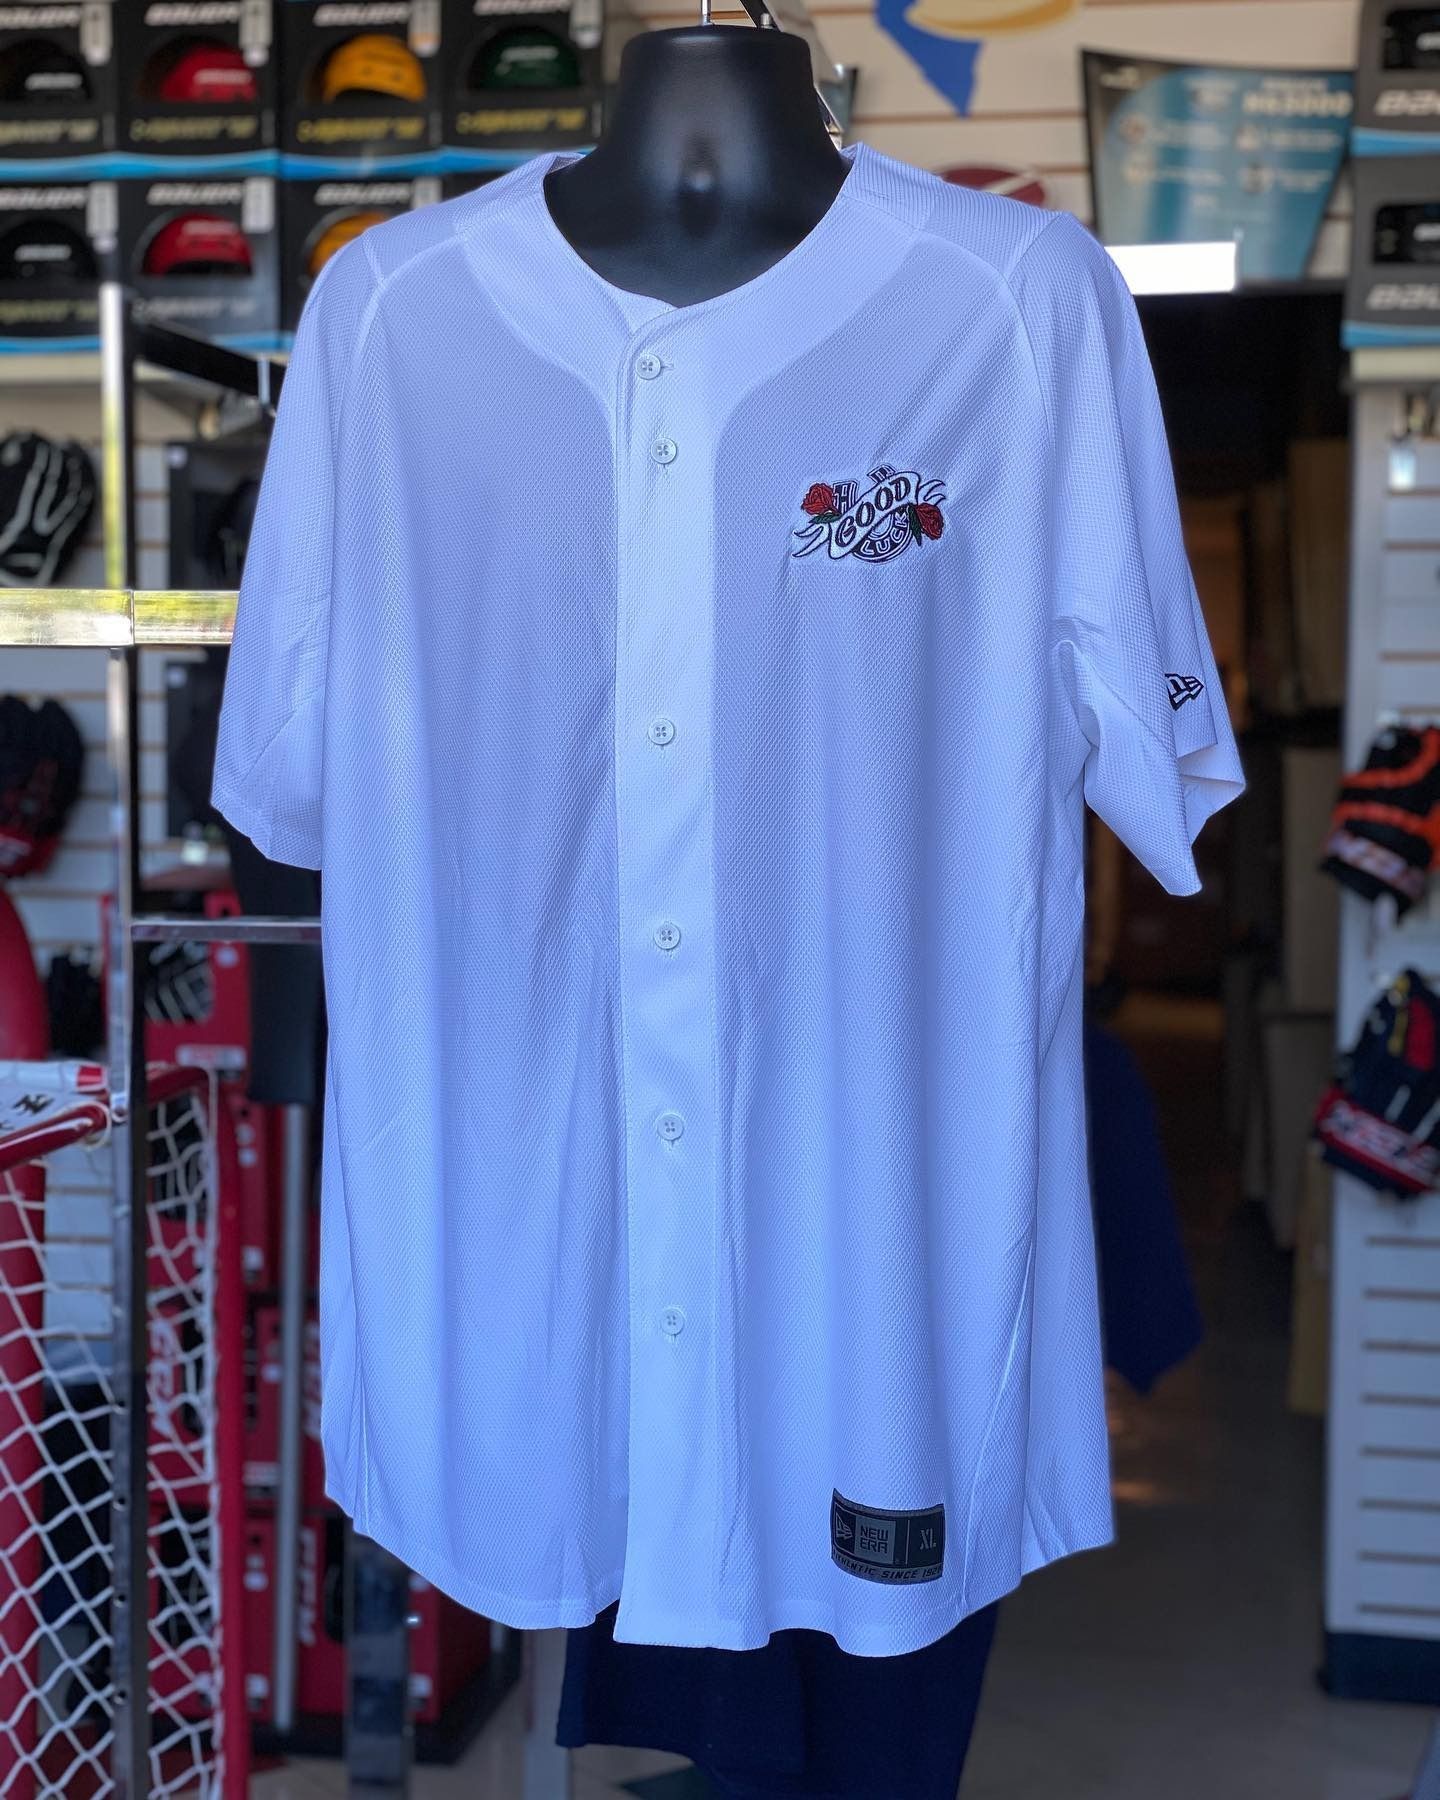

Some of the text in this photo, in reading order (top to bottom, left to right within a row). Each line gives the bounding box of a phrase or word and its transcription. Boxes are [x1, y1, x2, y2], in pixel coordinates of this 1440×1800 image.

[835, 476, 911, 548] GOOD
[860, 511, 908, 555] LUCK
[860, 1525, 889, 1540] NEW
[860, 1541, 888, 1554] ERA
[881, 1570, 918, 1579] SINCE
